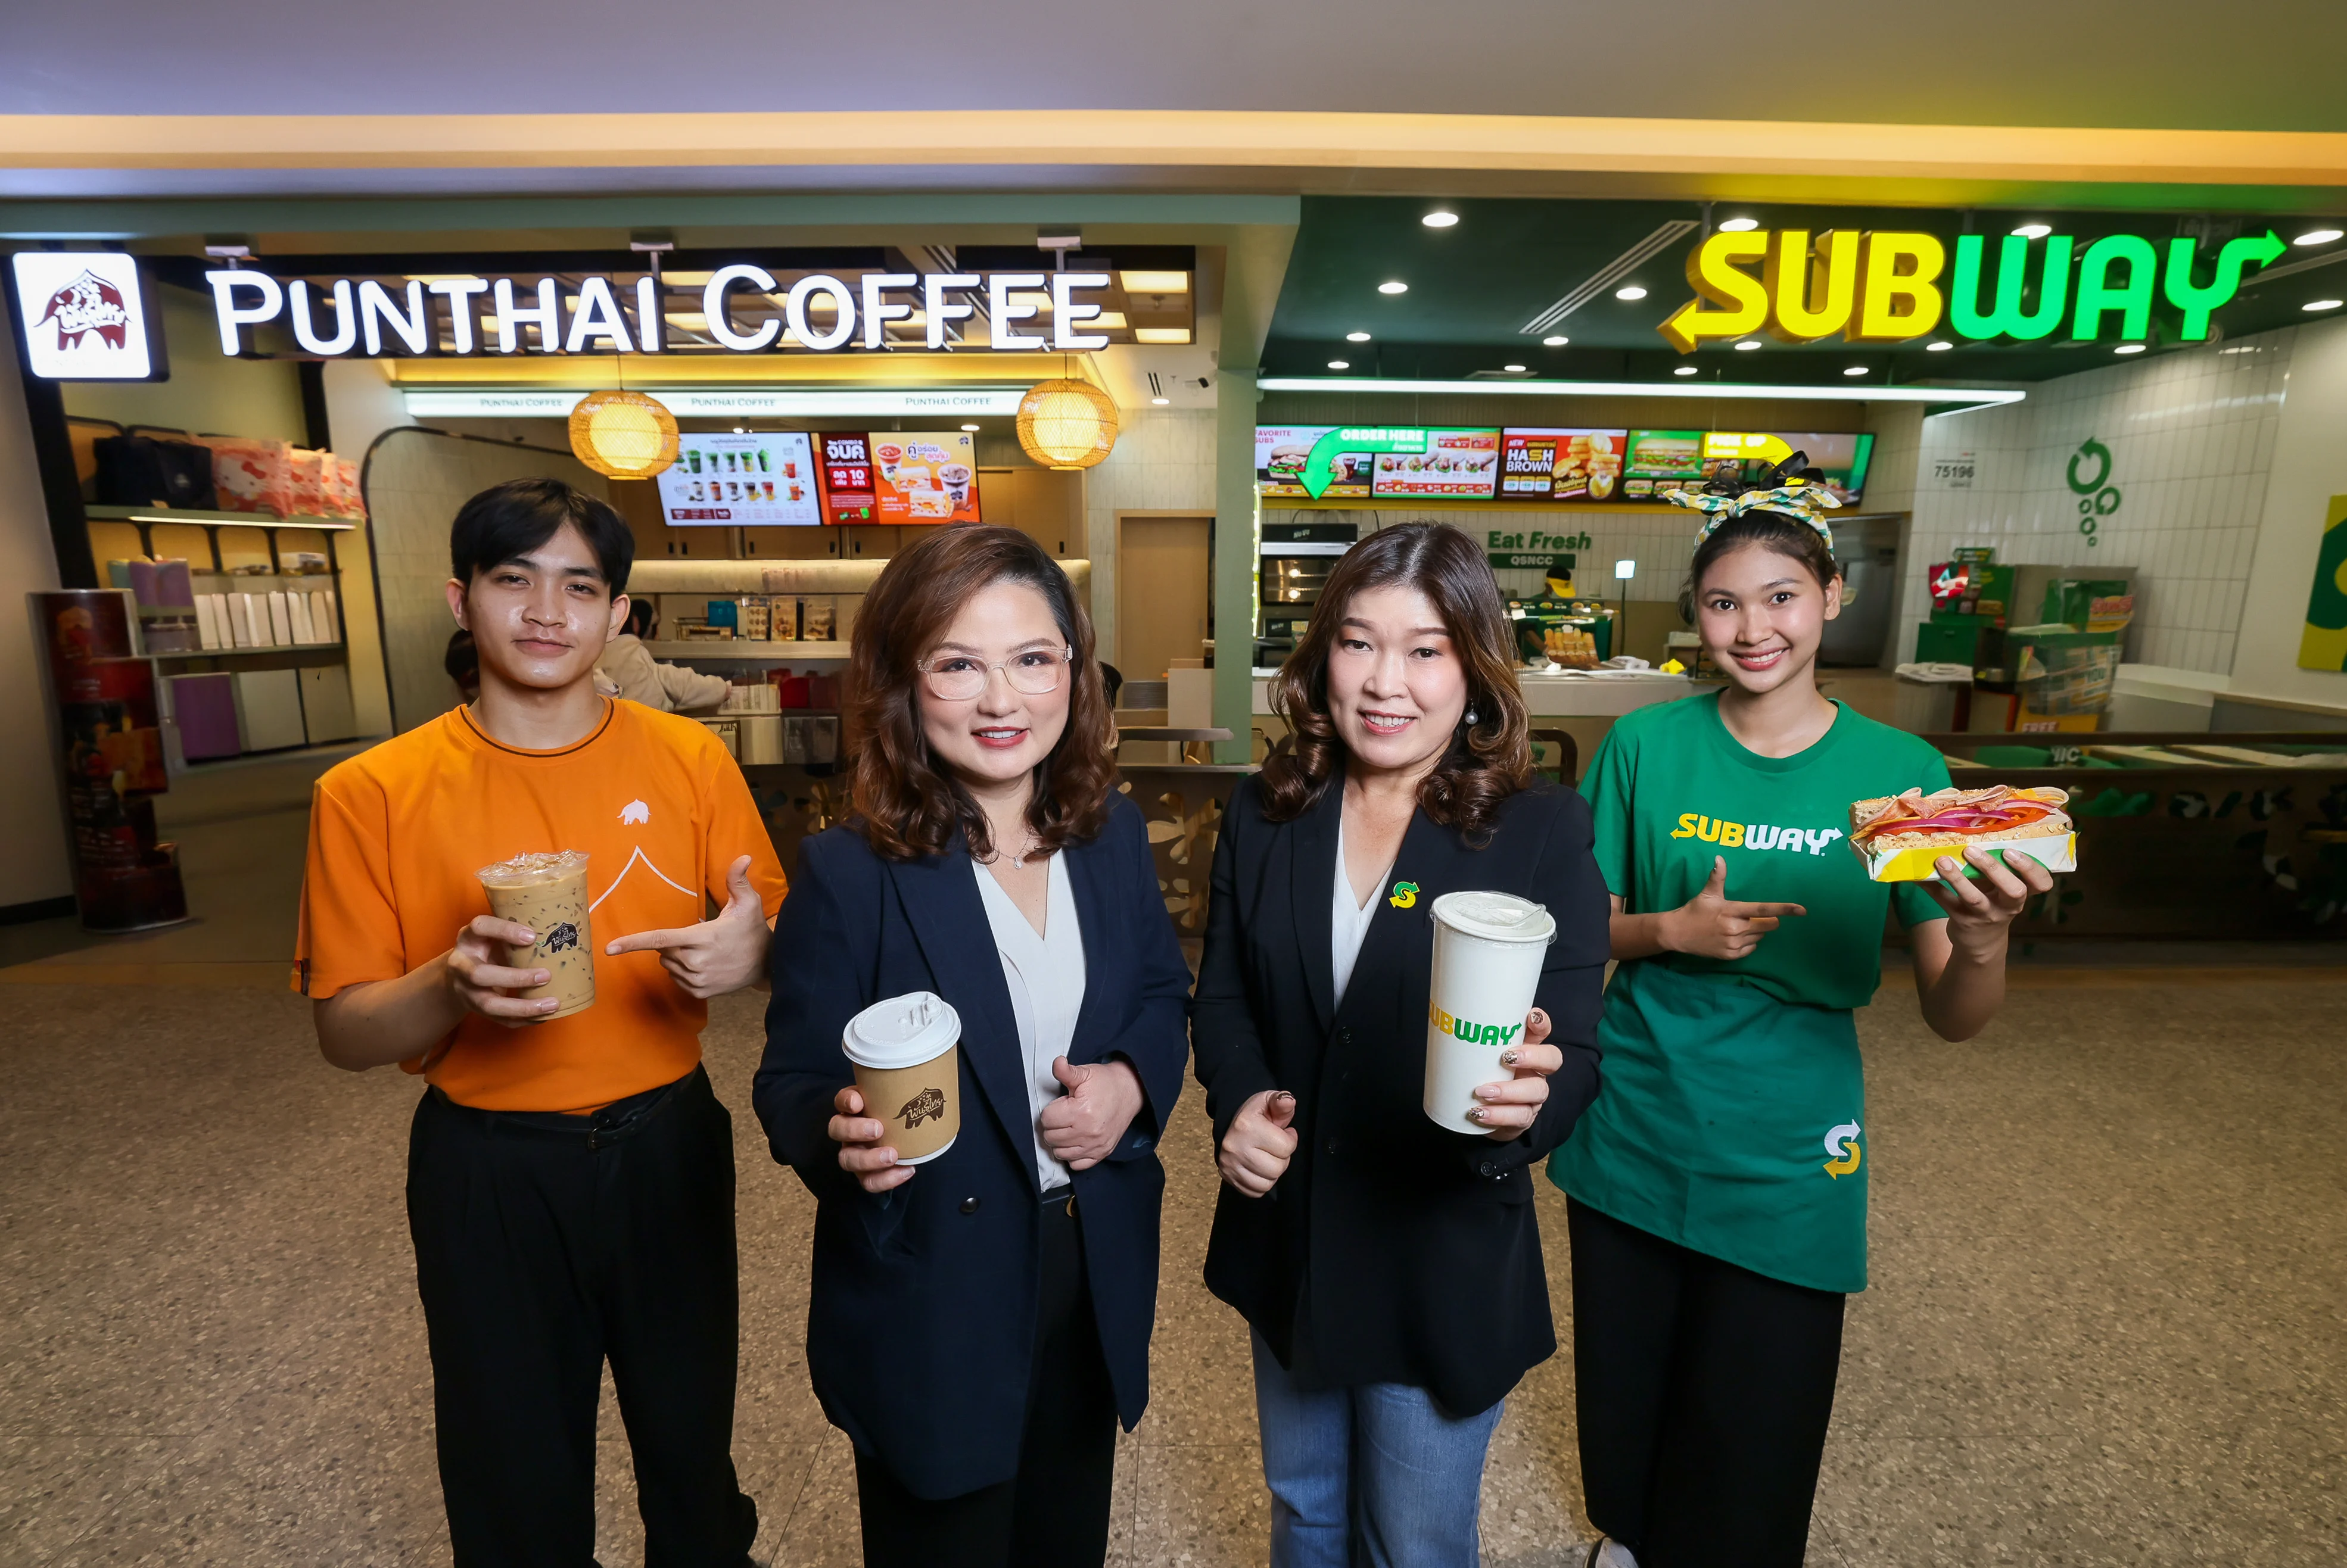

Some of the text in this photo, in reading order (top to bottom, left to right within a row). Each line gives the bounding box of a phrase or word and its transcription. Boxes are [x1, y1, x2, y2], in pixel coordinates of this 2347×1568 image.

[1670, 230, 2286, 344] SUBWAY
[205, 264, 1110, 356] PUNTHAI COFFEE
[525, 398, 562, 407] COFFEE
[691, 398, 775, 406] PUNTHAI COFFEE
[905, 397, 991, 406] PUNTHAI COFFEE
[1340, 429, 1387, 441] ORDER
[1389, 429, 1424, 442] HERE
[1507, 448, 1554, 462] HASH
[1506, 460, 1553, 472] BROWN
[849, 469, 865, 480] 10
[1488, 531, 1592, 550] Eat Fresh
[1510, 556, 1554, 565] QSNCC
[1670, 813, 1844, 856] SUBWAY
